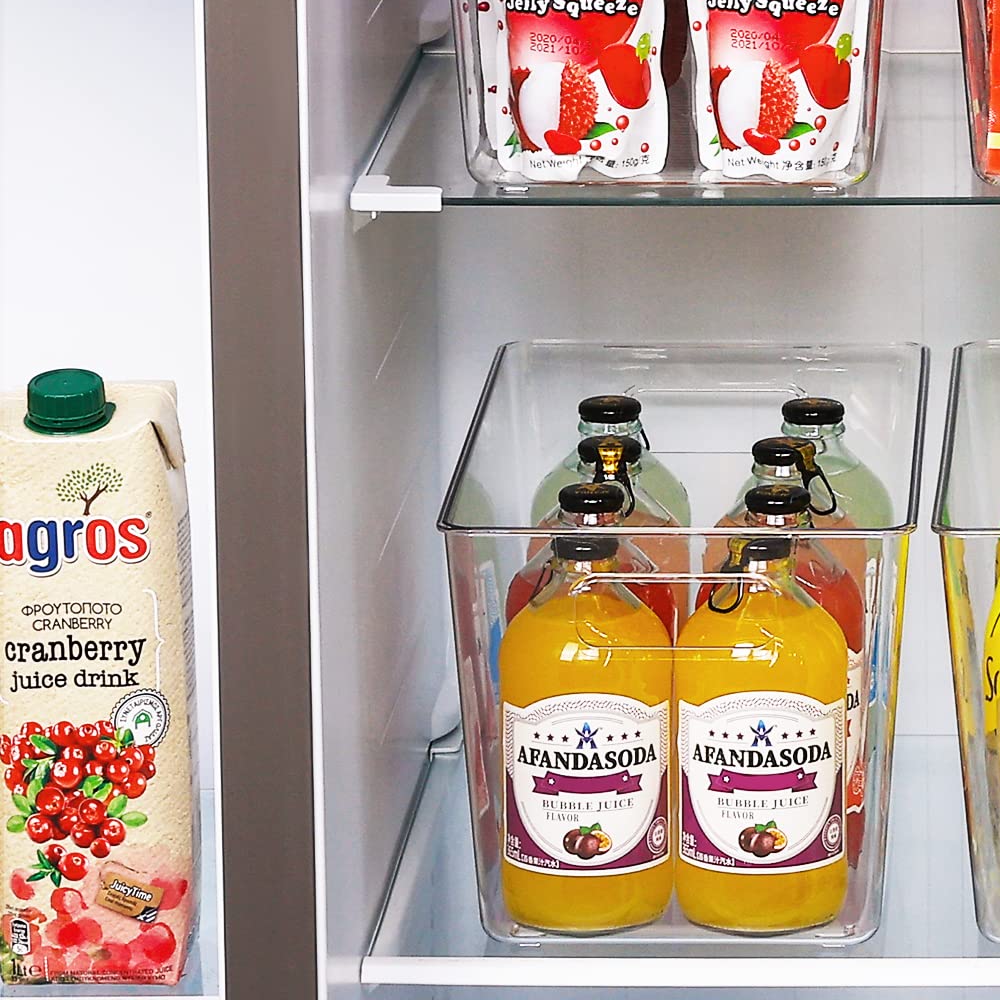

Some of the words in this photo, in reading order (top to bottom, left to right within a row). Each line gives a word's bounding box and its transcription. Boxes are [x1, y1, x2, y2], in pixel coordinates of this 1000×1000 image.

[529, 160, 546, 169] Net
[727, 158, 744, 167] Net
[0, 518, 148, 573] agros
[21, 602, 123, 617] ΦΡΟΥΤΟΠΟΤΟ
[32, 618, 113, 632] CRANBERRY
[5, 635, 147, 667] cranberry
[10, 669, 67, 692] juice
[74, 669, 140, 688] drink
[517, 743, 657, 771] AFANDASODA
[692, 741, 832, 768] AFANDASODA
[542, 799, 593, 810] BUBBLE
[596, 798, 634, 812] JUICE
[717, 797, 768, 808] BUBBLE
[772, 795, 809, 809] JUICE
[546, 811, 579, 822] FLAVOR
[721, 809, 754, 819] FLAVOR
[110, 878, 153, 903] JuicyTime
